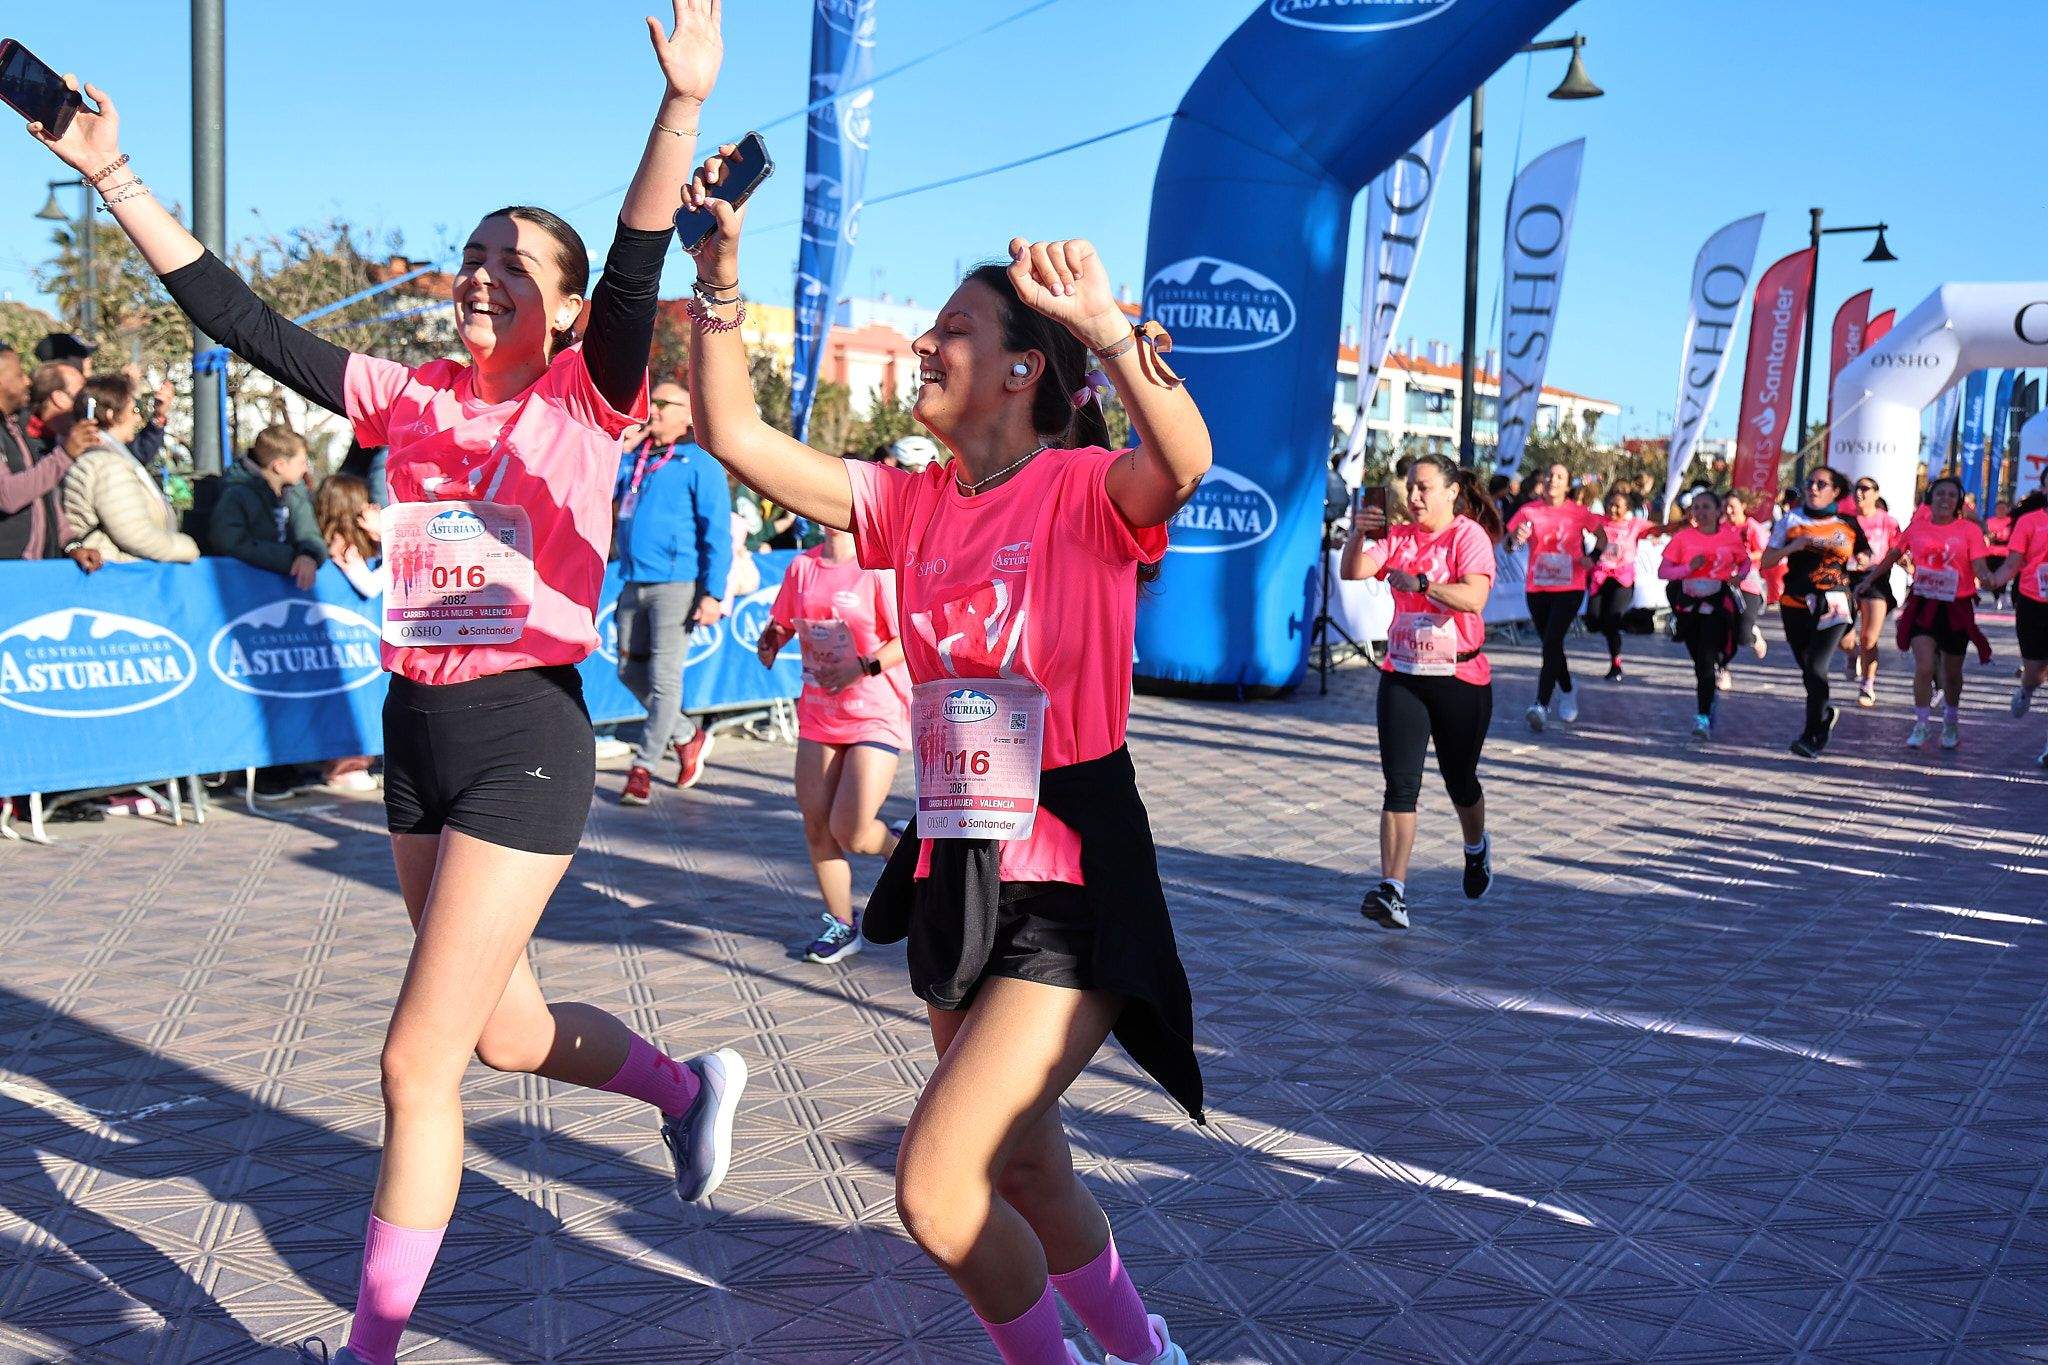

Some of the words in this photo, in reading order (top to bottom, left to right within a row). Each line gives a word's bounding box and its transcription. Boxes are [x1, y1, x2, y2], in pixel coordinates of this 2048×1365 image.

[1759, 286, 1794, 403] Santander
[1871, 352, 1940, 369] OYSHO
[430, 522, 483, 534] ASTURIANA
[431, 565, 486, 589] 016
[442, 595, 467, 605] 2082
[403, 610, 431, 619] CARRERA
[431, 610, 441, 618] DE
[441, 610, 450, 618] LA
[451, 609, 474, 617] MUJER
[479, 608, 513, 616] VALENCIA
[401, 625, 442, 638] OYSHO
[470, 626, 515, 636] Santander
[25, 645, 97, 659] CENTRAL
[100, 640, 172, 657] LECHERA
[1409, 640, 1434, 651] 016
[227, 638, 380, 678] ASTURIANA
[0, 651, 184, 694] ASTURIANA
[944, 703, 991, 715] ASTURIANA
[944, 749, 991, 776] 016
[953, 798, 974, 807] MUJER
[980, 799, 1015, 809] VALENCIA
[968, 818, 1016, 830] Santander
